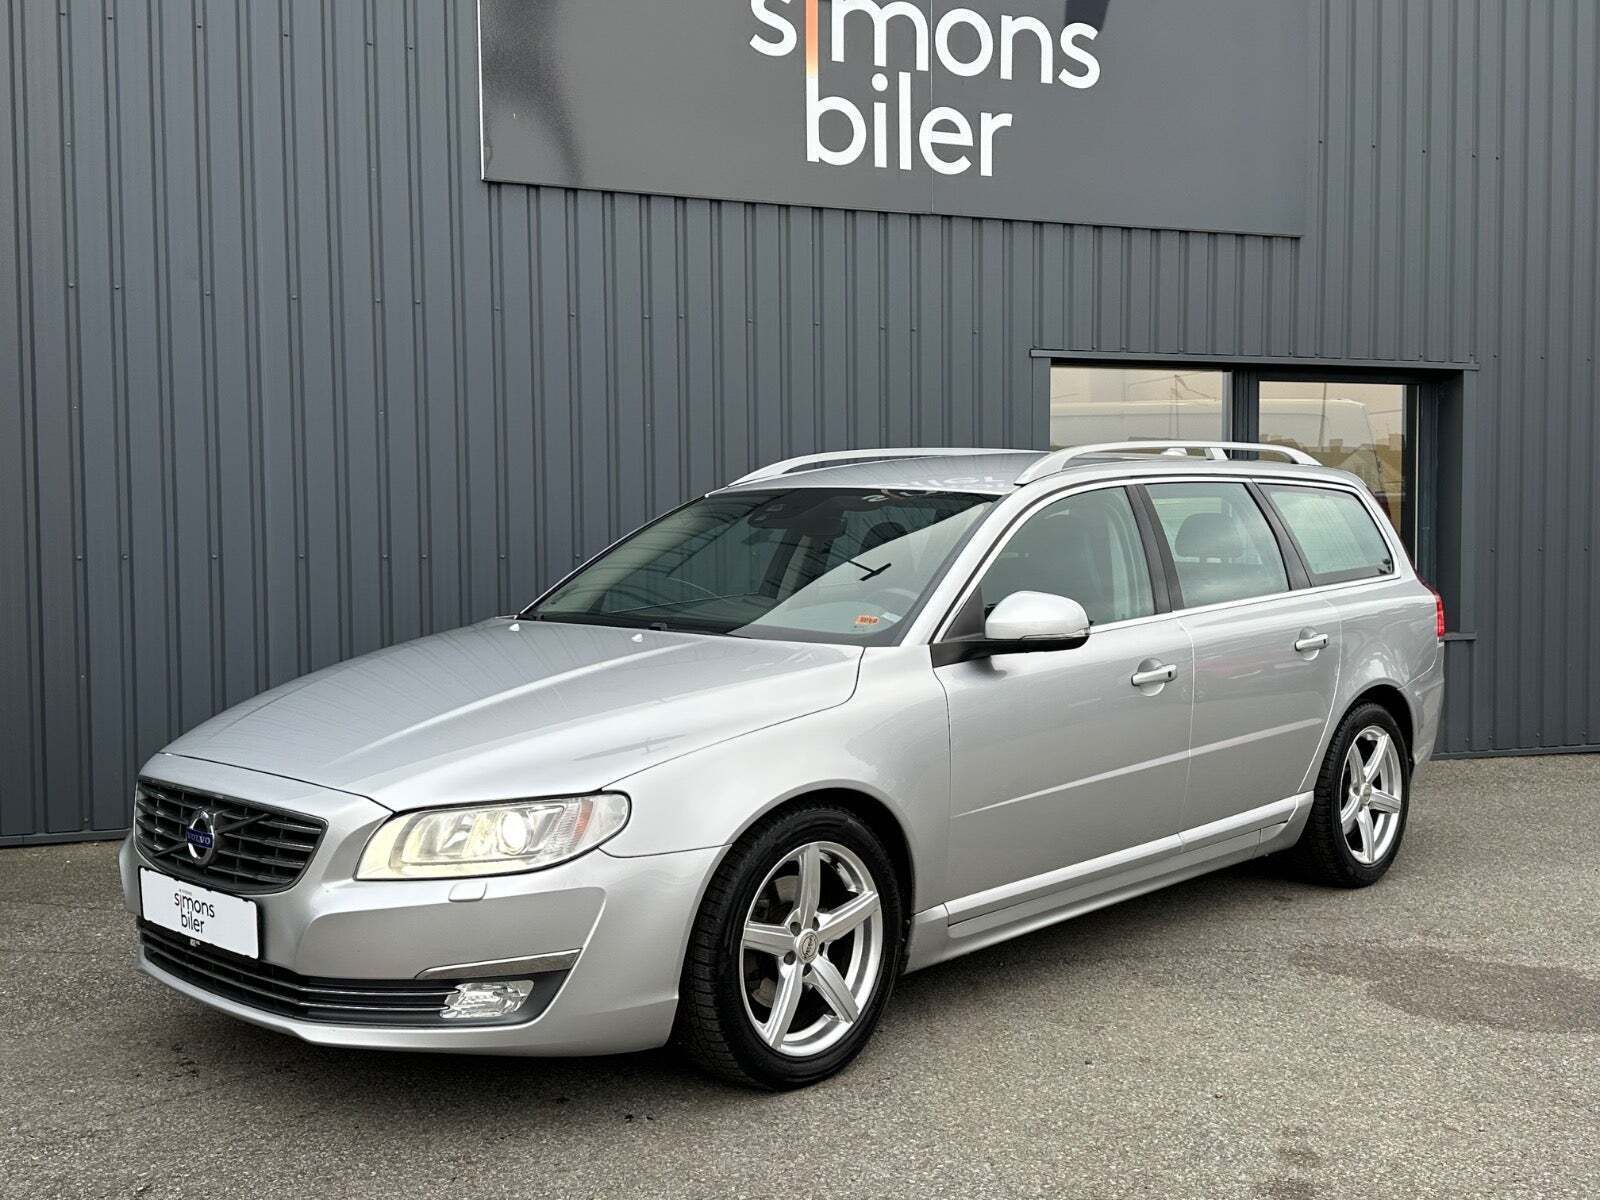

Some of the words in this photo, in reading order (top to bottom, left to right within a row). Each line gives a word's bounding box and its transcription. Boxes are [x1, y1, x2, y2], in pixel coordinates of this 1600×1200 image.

[749, 0, 1101, 89] simons
[805, 72, 1013, 177] biler
[187, 831, 211, 845] VOLVO
[174, 891, 215, 918] simons
[180, 911, 205, 934] biler
